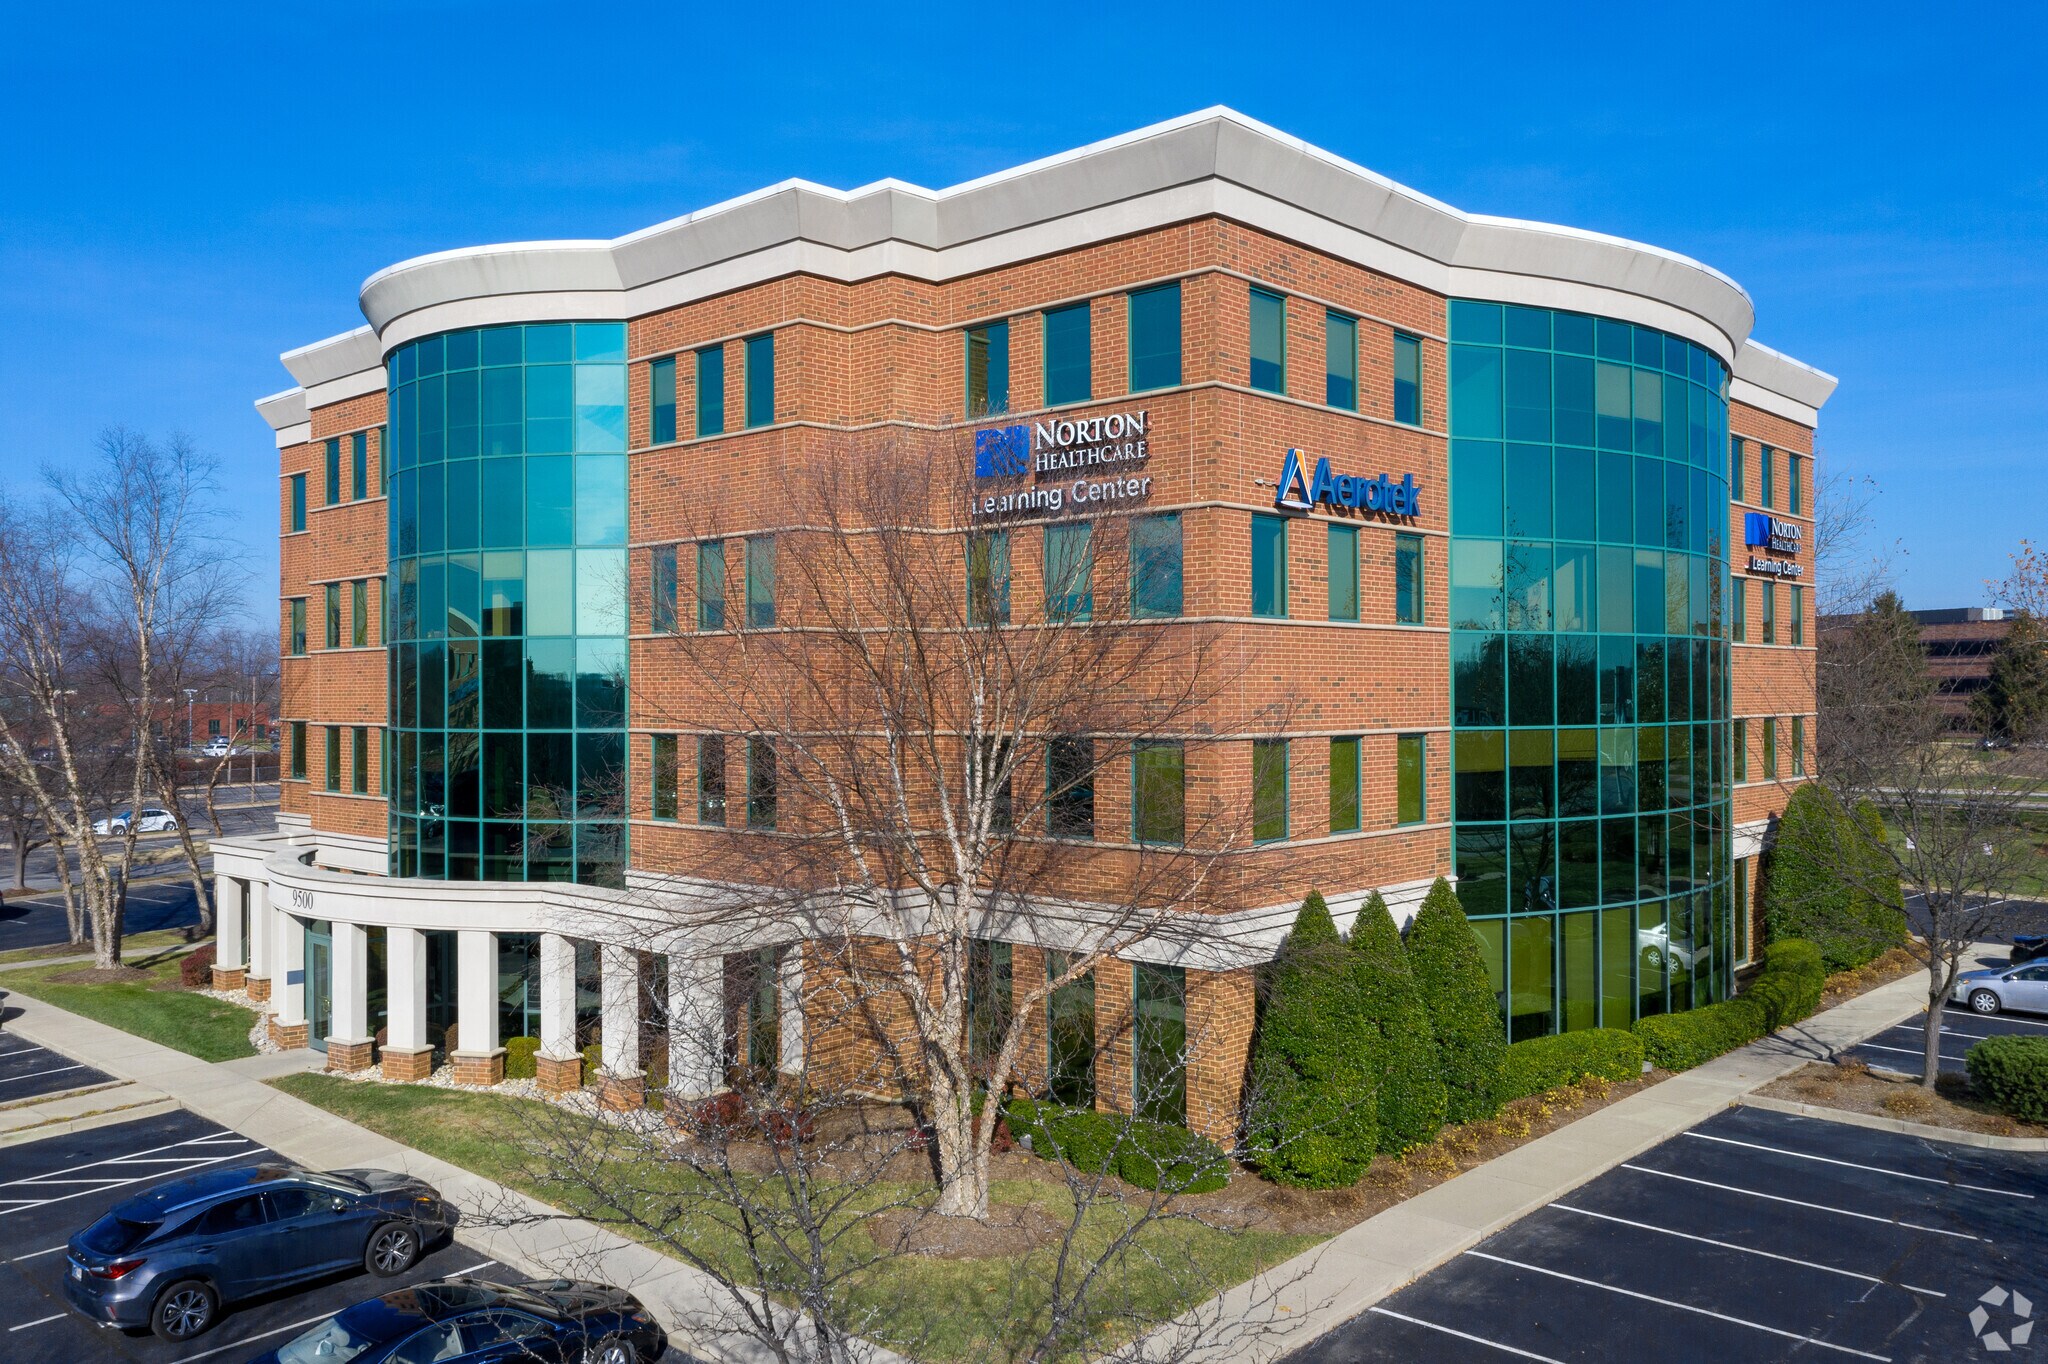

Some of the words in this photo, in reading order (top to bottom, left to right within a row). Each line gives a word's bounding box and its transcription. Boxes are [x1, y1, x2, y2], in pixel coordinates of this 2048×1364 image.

[1035, 411, 1146, 450] NORTON
[1035, 440, 1147, 472] HEALTHCARE
[972, 486, 1062, 515] Learning
[1071, 476, 1151, 503] Center
[1312, 458, 1422, 516] Aerotek
[1772, 518, 1802, 539] NORTON
[1753, 556, 1781, 576] Learning
[1783, 561, 1803, 576] Center
[293, 889, 313, 909] 9500
